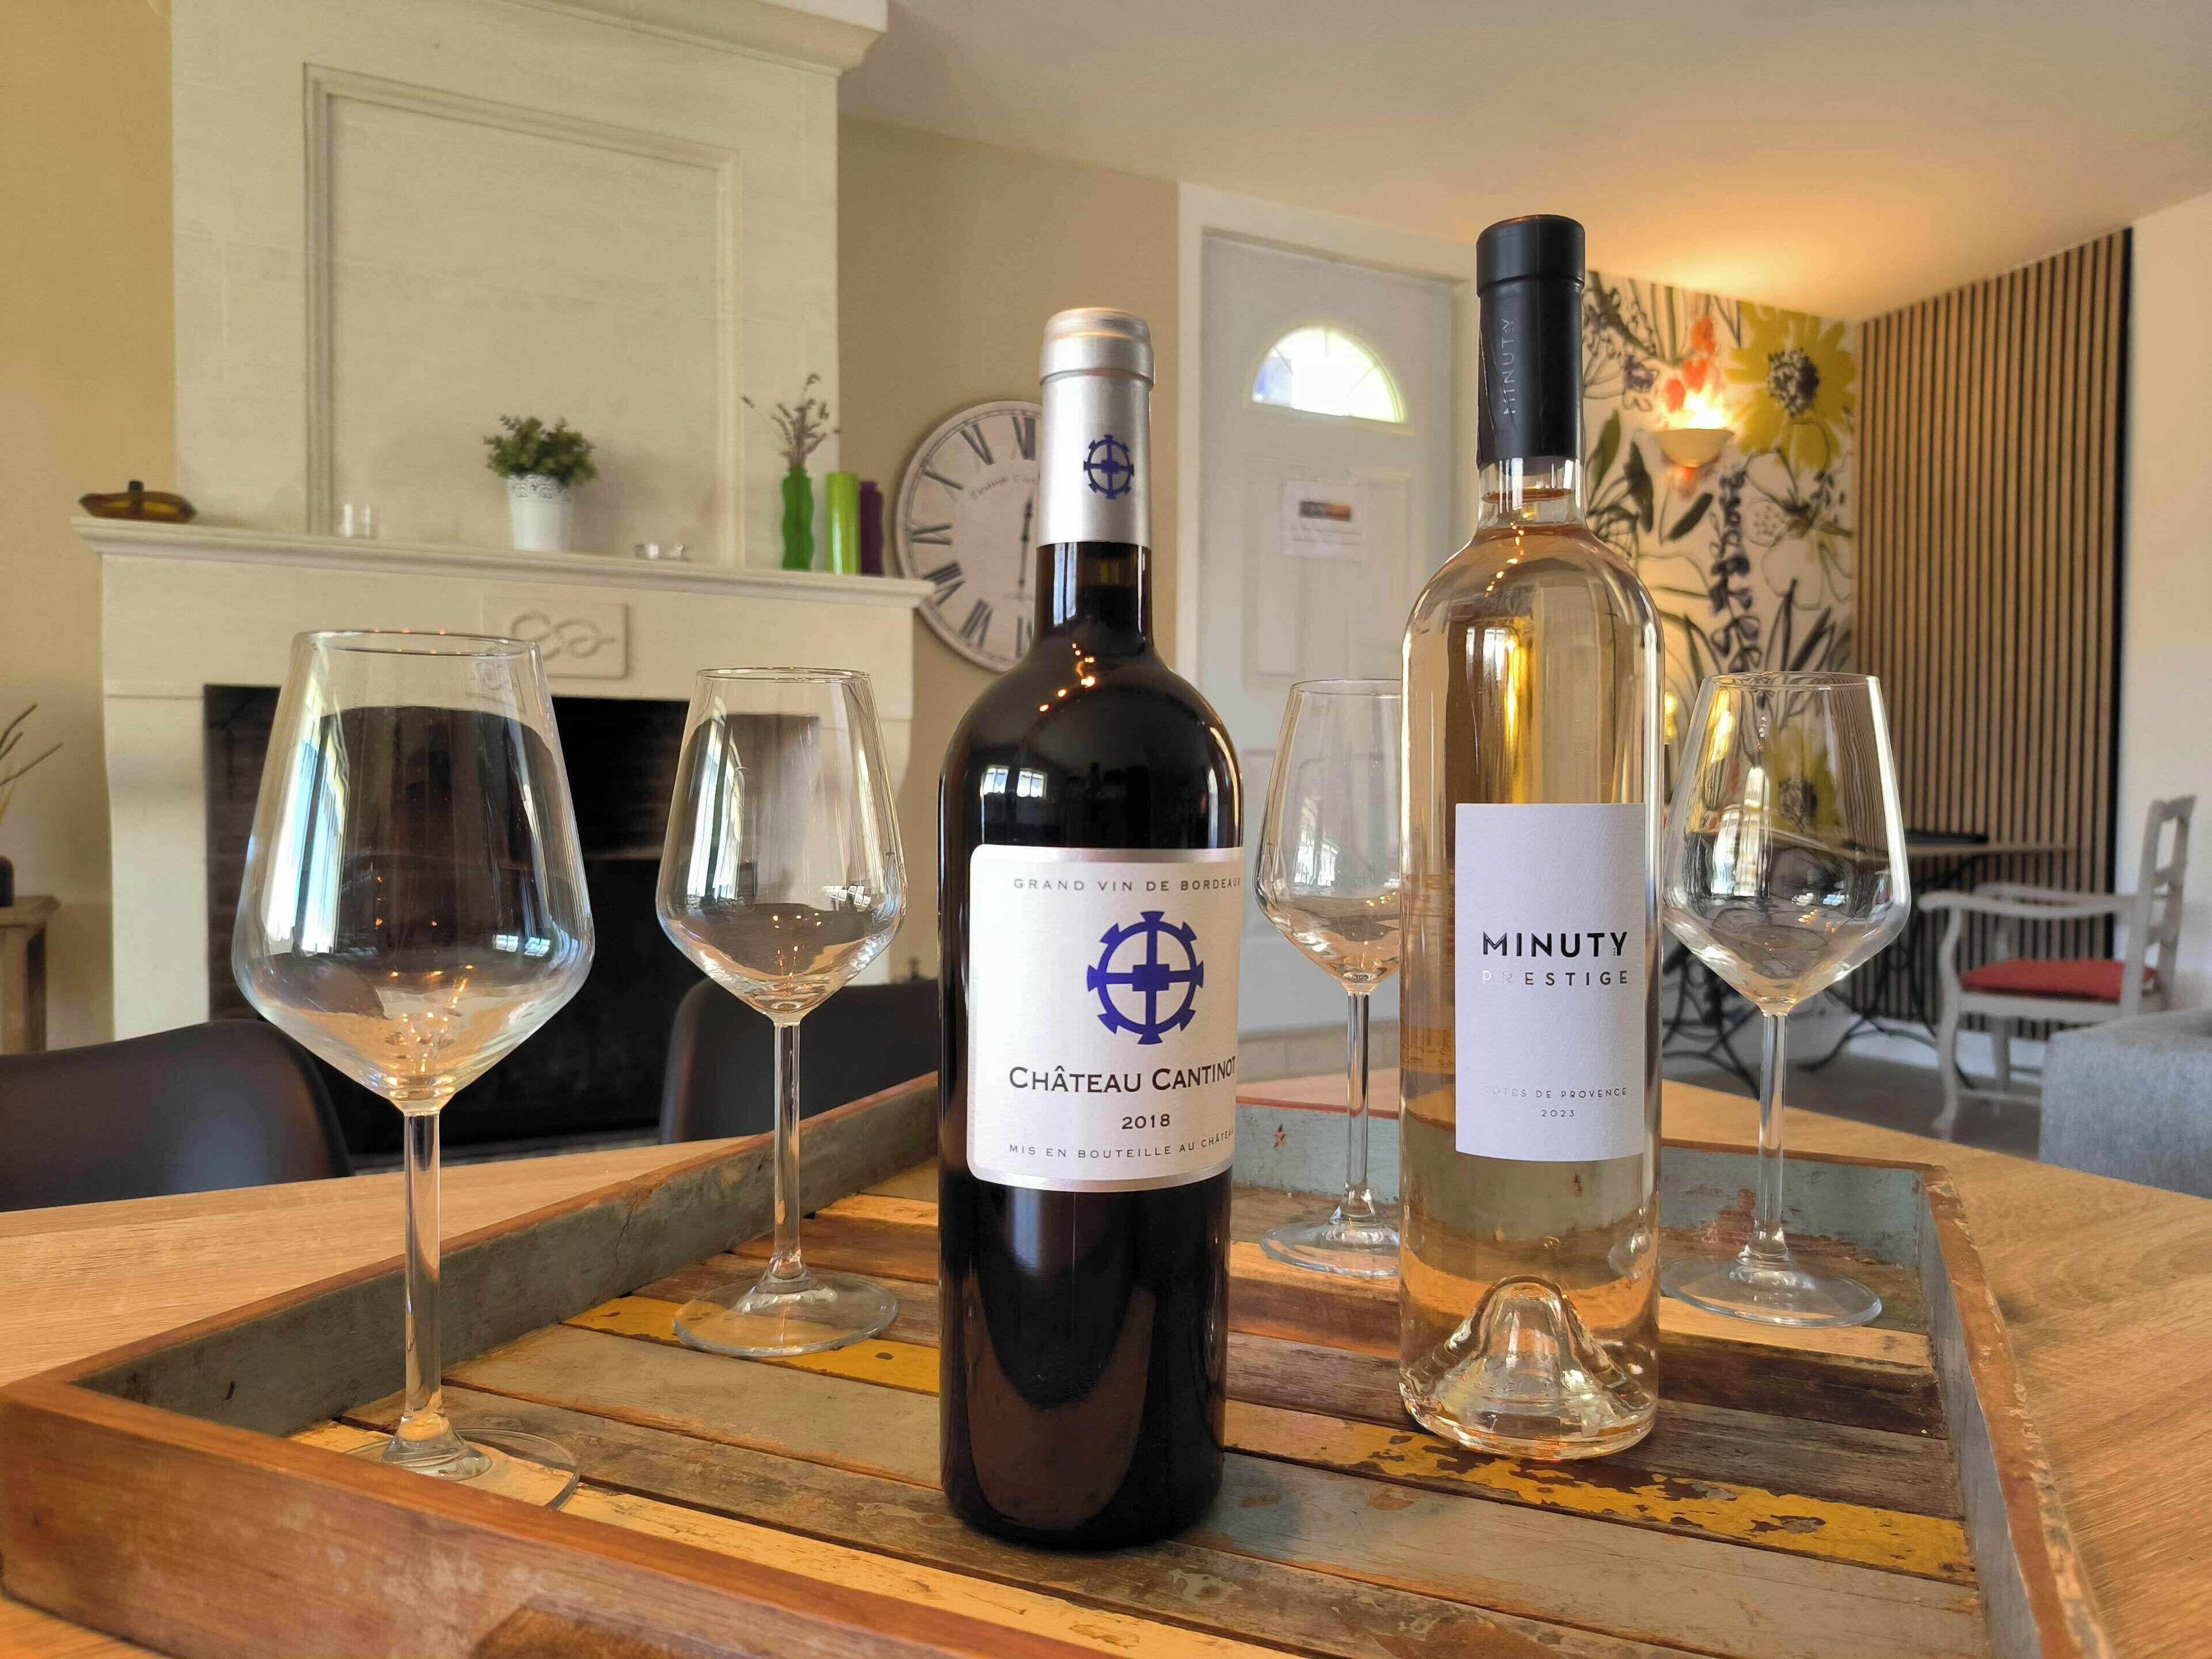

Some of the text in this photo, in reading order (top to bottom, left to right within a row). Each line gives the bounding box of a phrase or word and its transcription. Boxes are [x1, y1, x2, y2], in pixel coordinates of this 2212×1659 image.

[1501, 318, 1516, 415] MINUTY
[1013, 878, 1085, 891] GRAND
[1098, 881, 1132, 892] VIN
[1146, 881, 1169, 892] DE
[1483, 931, 1627, 957] MINUTY
[1482, 969, 1627, 986] PRESTIGE
[1535, 1089, 1552, 1099] DE
[1560, 1086, 1627, 1099] PROVENCE
[1122, 1113, 1171, 1130] 2018
[1540, 1109, 1575, 1118] 2023
[1009, 1143, 1036, 1156] MIS
[1046, 1148, 1067, 1158] EN
[1078, 1146, 1172, 1159] BOUTEILLE
[1179, 1142, 1195, 1153] AU
